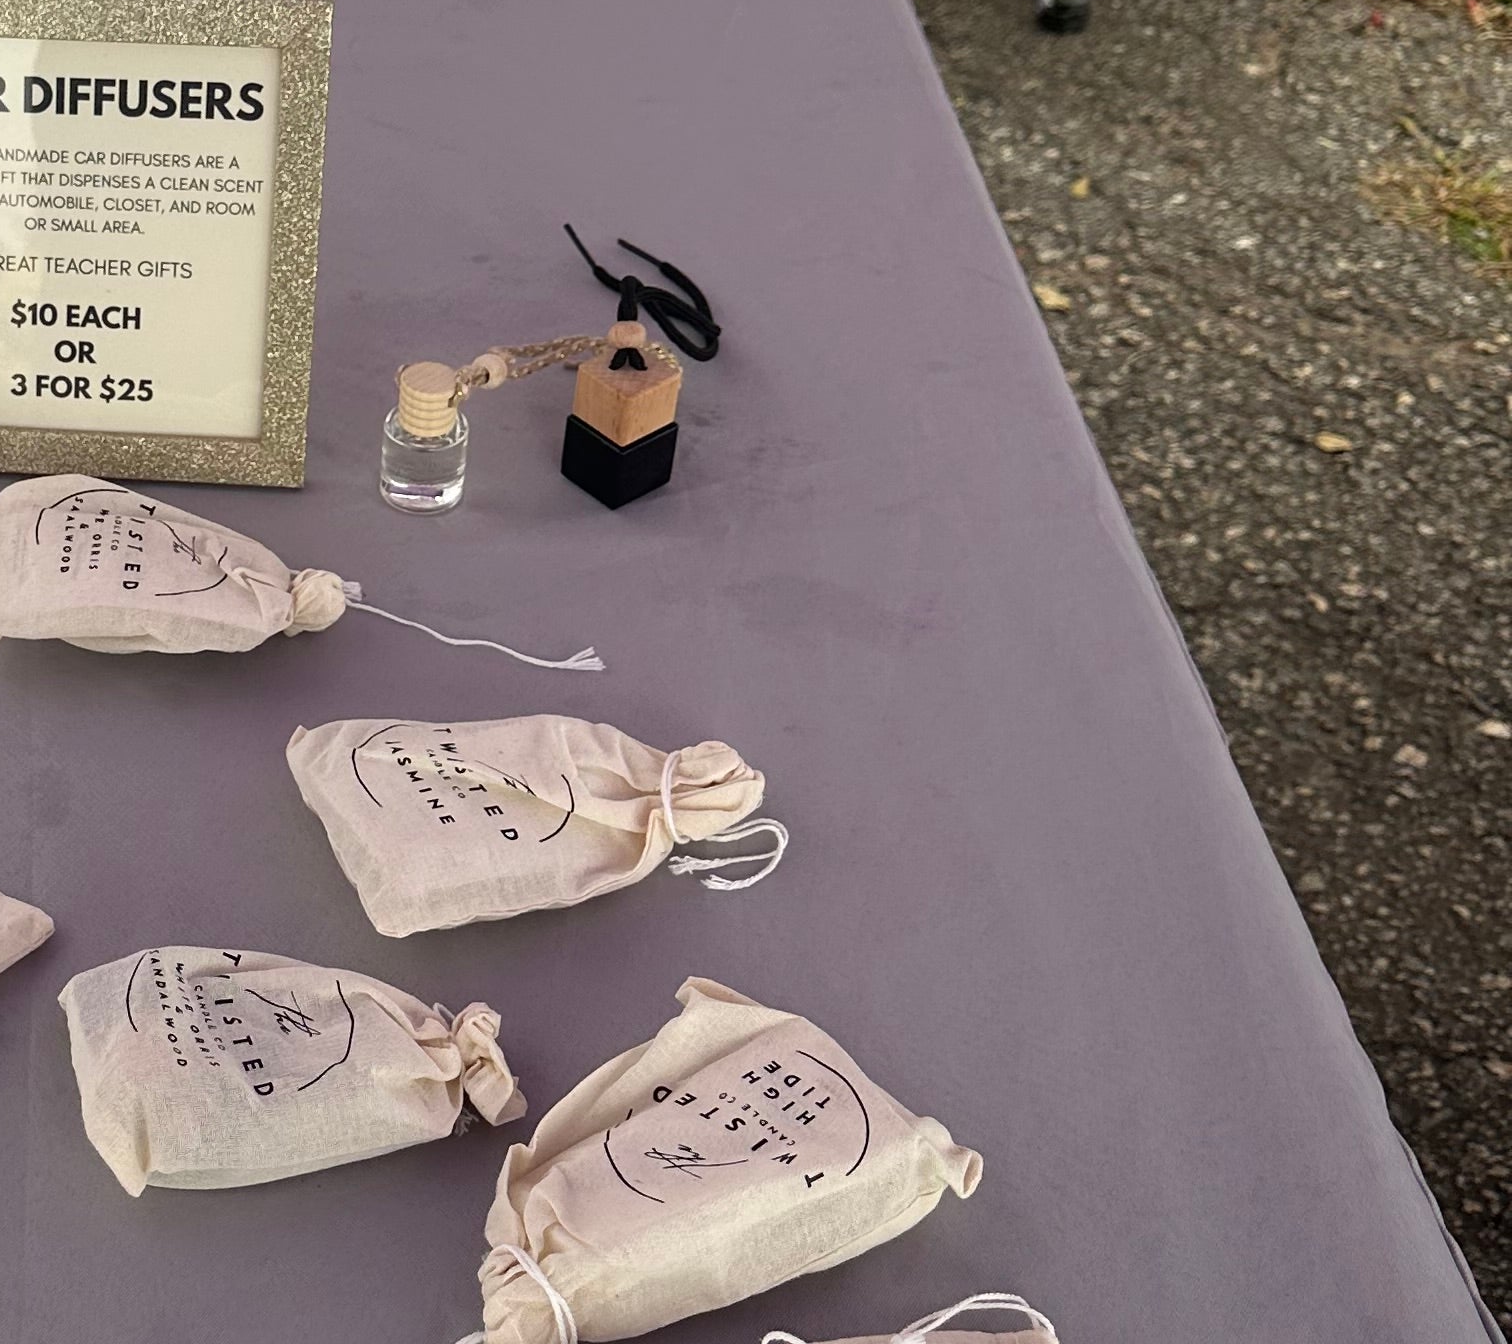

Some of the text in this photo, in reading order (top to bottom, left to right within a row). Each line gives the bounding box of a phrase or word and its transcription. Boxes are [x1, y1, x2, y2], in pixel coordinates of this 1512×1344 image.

[23, 77, 264, 121] DIFFUSERS
[74, 150, 106, 166] CAR
[110, 152, 191, 169] DIFFUSERS
[195, 155, 224, 170] ARE
[229, 156, 240, 171] A
[21, 171, 54, 186] THAT
[59, 173, 141, 190] DISPENSES
[145, 176, 155, 190] A
[160, 177, 209, 193] CLEAN
[213, 179, 264, 195] SCENT
[24, 217, 145, 235] OR SMALL AREA.
[103, 198, 164, 215] CLOSET,
[169, 200, 202, 215] AND
[206, 201, 256, 216] ROOM
[44, 257, 131, 278] TEACHER
[137, 260, 193, 279] GIFTS
[11, 299, 142, 331] $10 EACH
[54, 341, 97, 364] OR
[11, 374, 154, 403] 3 FOR $25
[122, 503, 156, 590] TISTED
[433, 727, 519, 841] TWISTED
[451, 785, 466, 799] CO
[149, 950, 188, 1067] SANDALWOOD
[194, 984, 226, 1052] CANDLE CO
[214, 951, 274, 1096] TISTED
[190, 1024, 220, 1068] ORRIS
[741, 1070, 816, 1125] HIGH
[763, 1060, 831, 1109] TIDE
[652, 1085, 825, 1189] TWISTED
[718, 1092, 796, 1147] CANDLE CO
